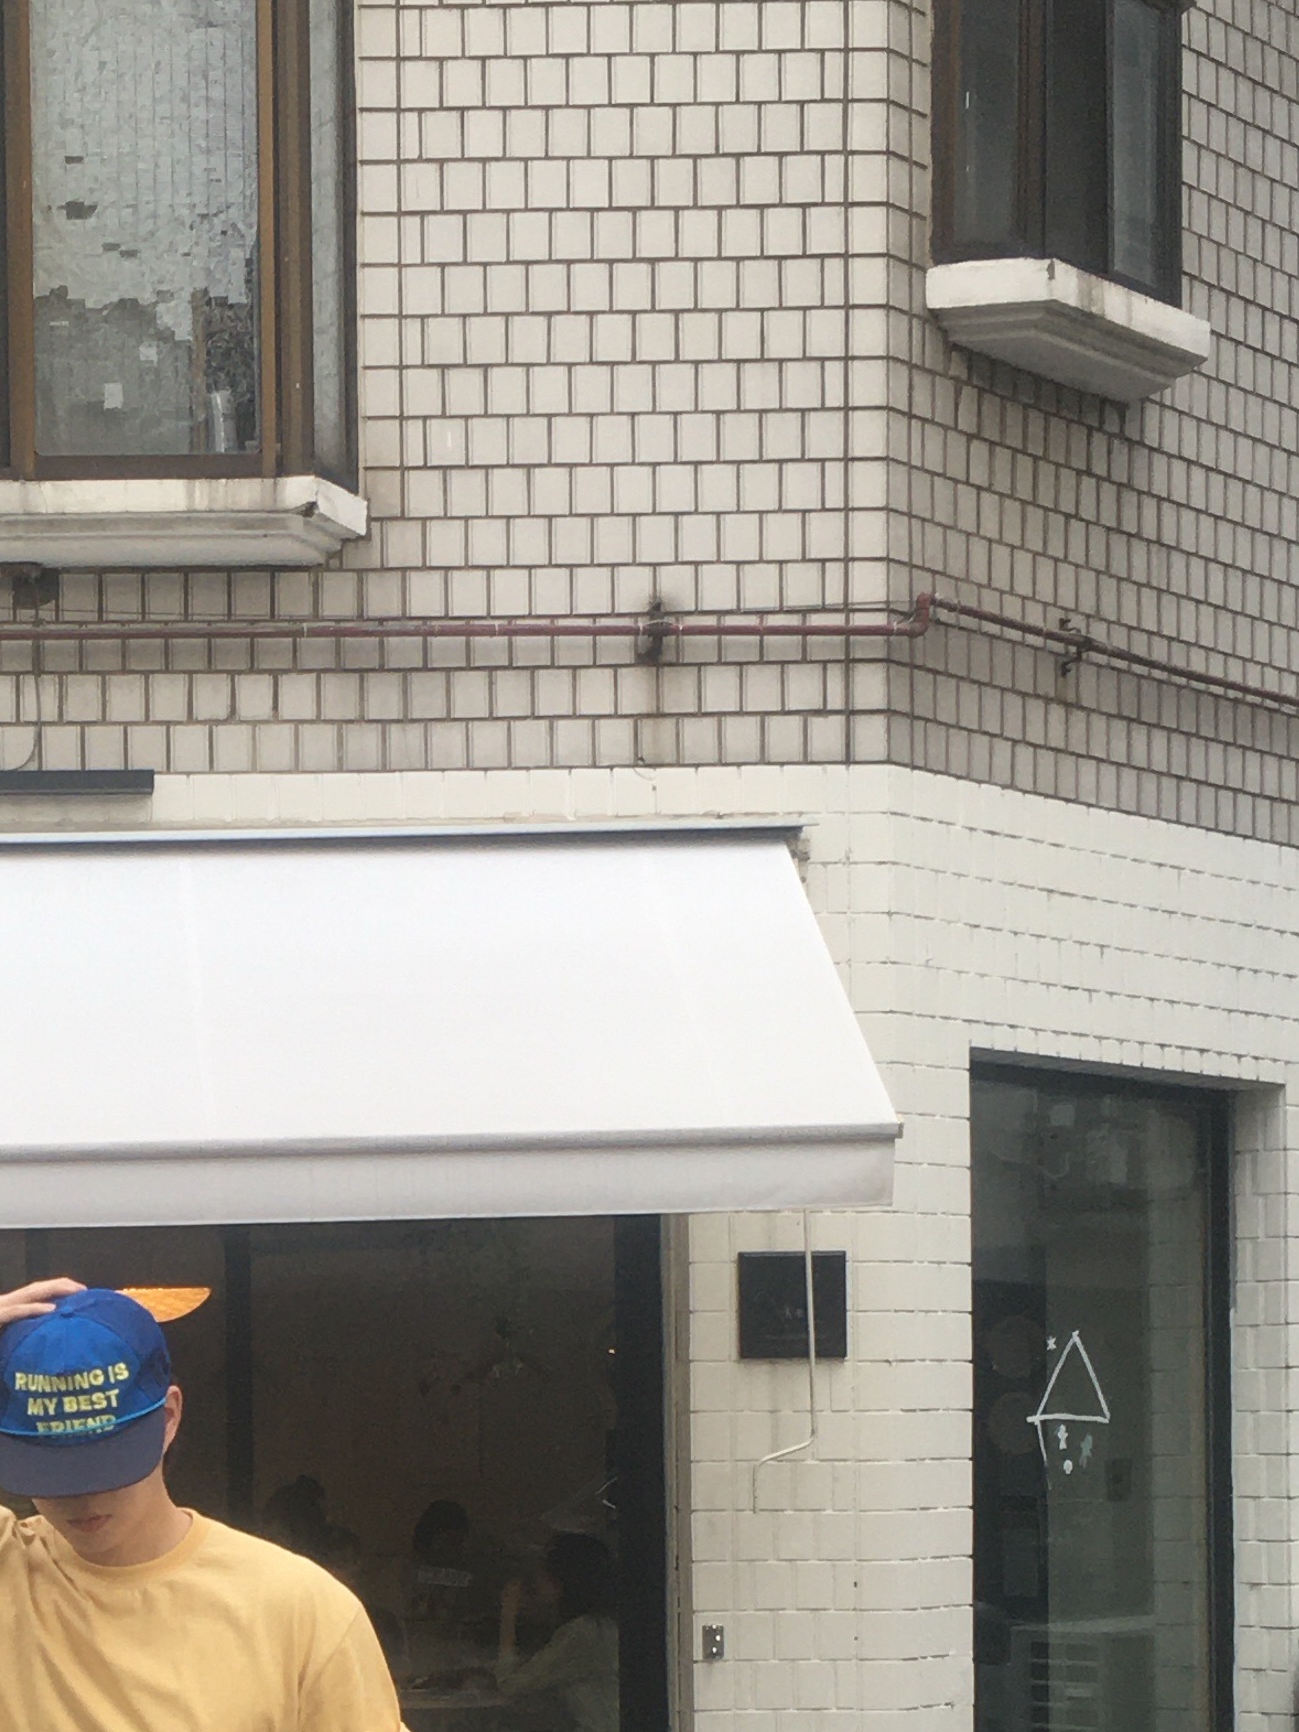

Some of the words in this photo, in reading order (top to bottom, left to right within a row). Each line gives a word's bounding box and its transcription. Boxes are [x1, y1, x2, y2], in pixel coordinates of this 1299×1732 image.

[14, 1369, 104, 1393] RUNNING
[108, 1362, 129, 1384] IS
[27, 1397, 57, 1416] MY
[63, 1388, 119, 1413] BEST
